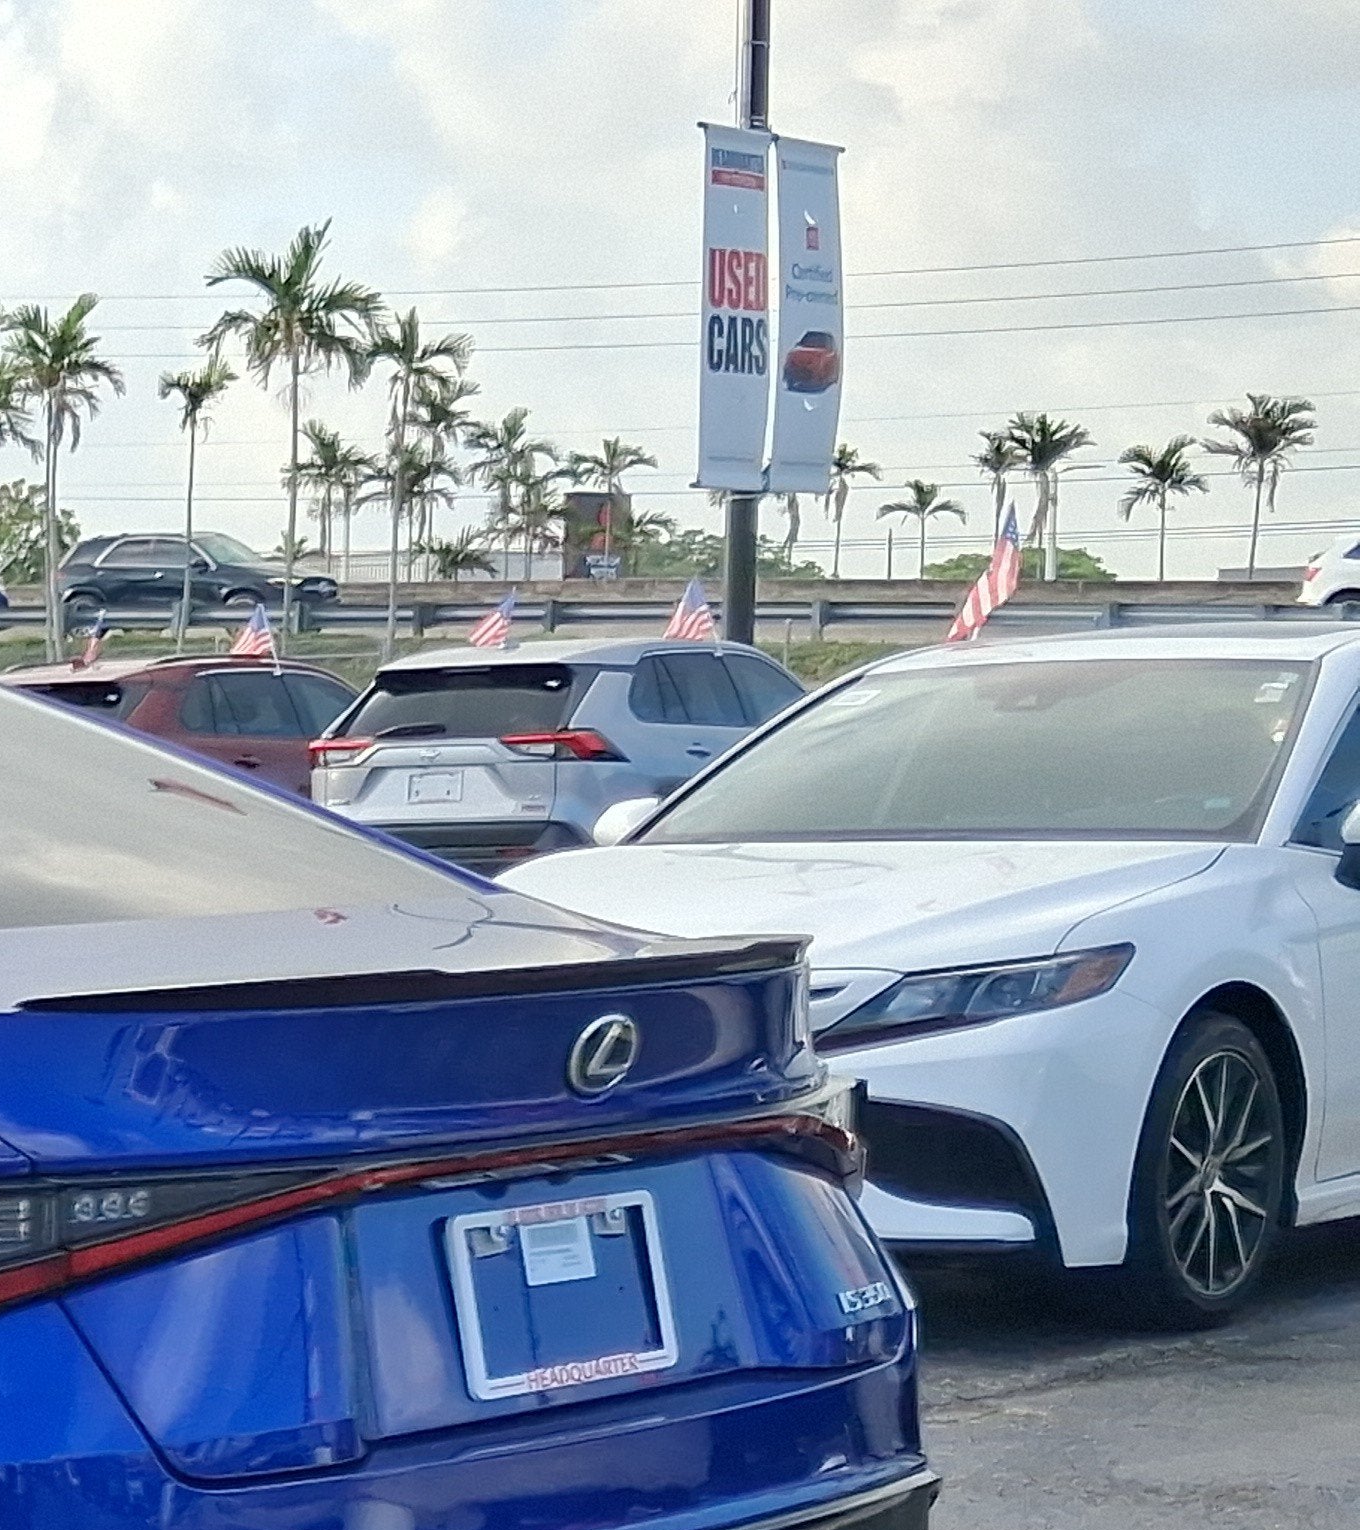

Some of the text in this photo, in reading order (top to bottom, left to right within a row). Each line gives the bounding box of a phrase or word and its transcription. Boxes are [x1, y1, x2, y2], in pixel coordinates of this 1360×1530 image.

[708, 248, 767, 312] USED
[707, 313, 767, 376] CARS
[527, 1353, 639, 1390] HEADQUARTER
